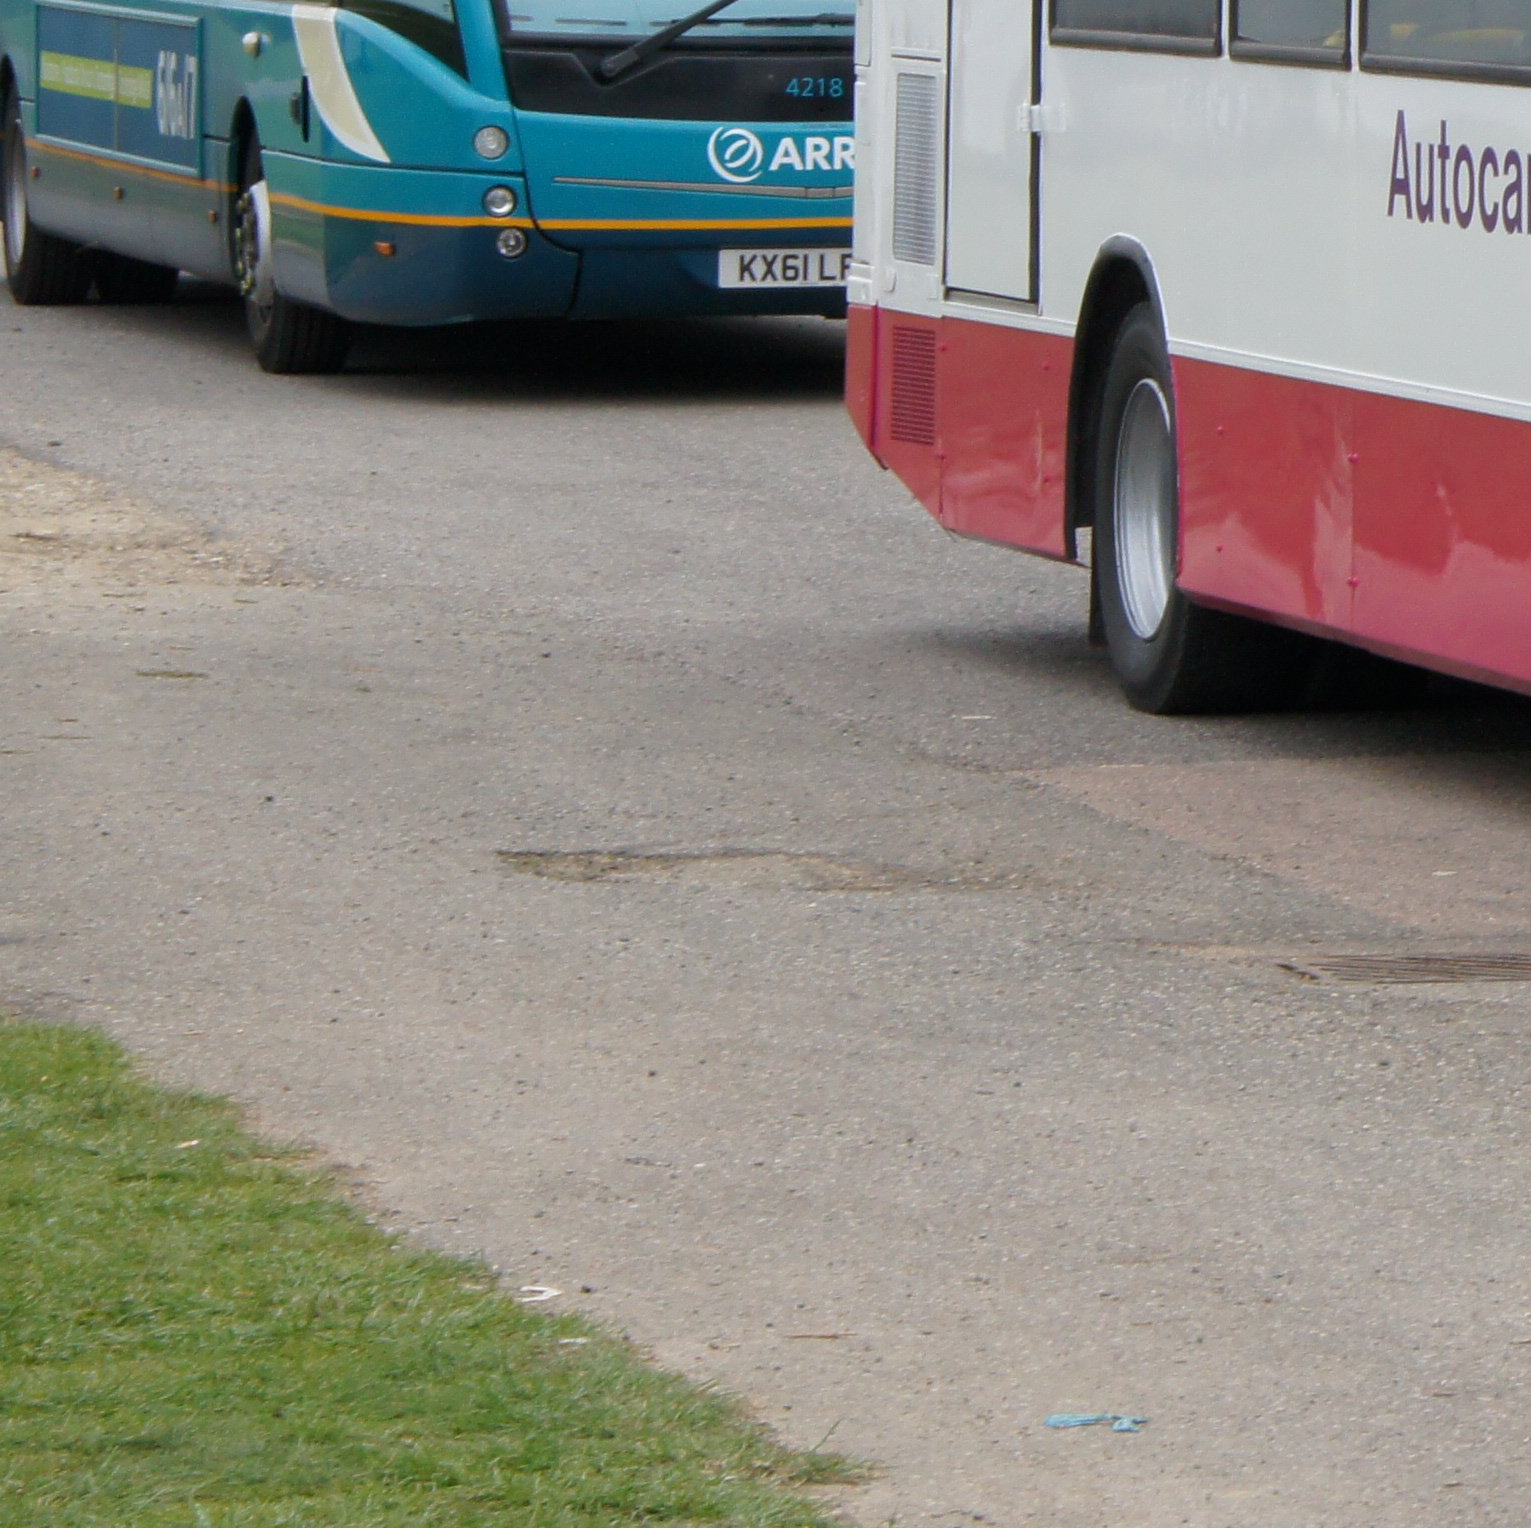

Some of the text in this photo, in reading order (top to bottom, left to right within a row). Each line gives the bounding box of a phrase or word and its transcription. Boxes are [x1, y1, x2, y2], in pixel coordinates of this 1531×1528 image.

[785, 77, 843, 97] 4218
[768, 136, 855, 171] ARR
[739, 254, 808, 281] KX61
